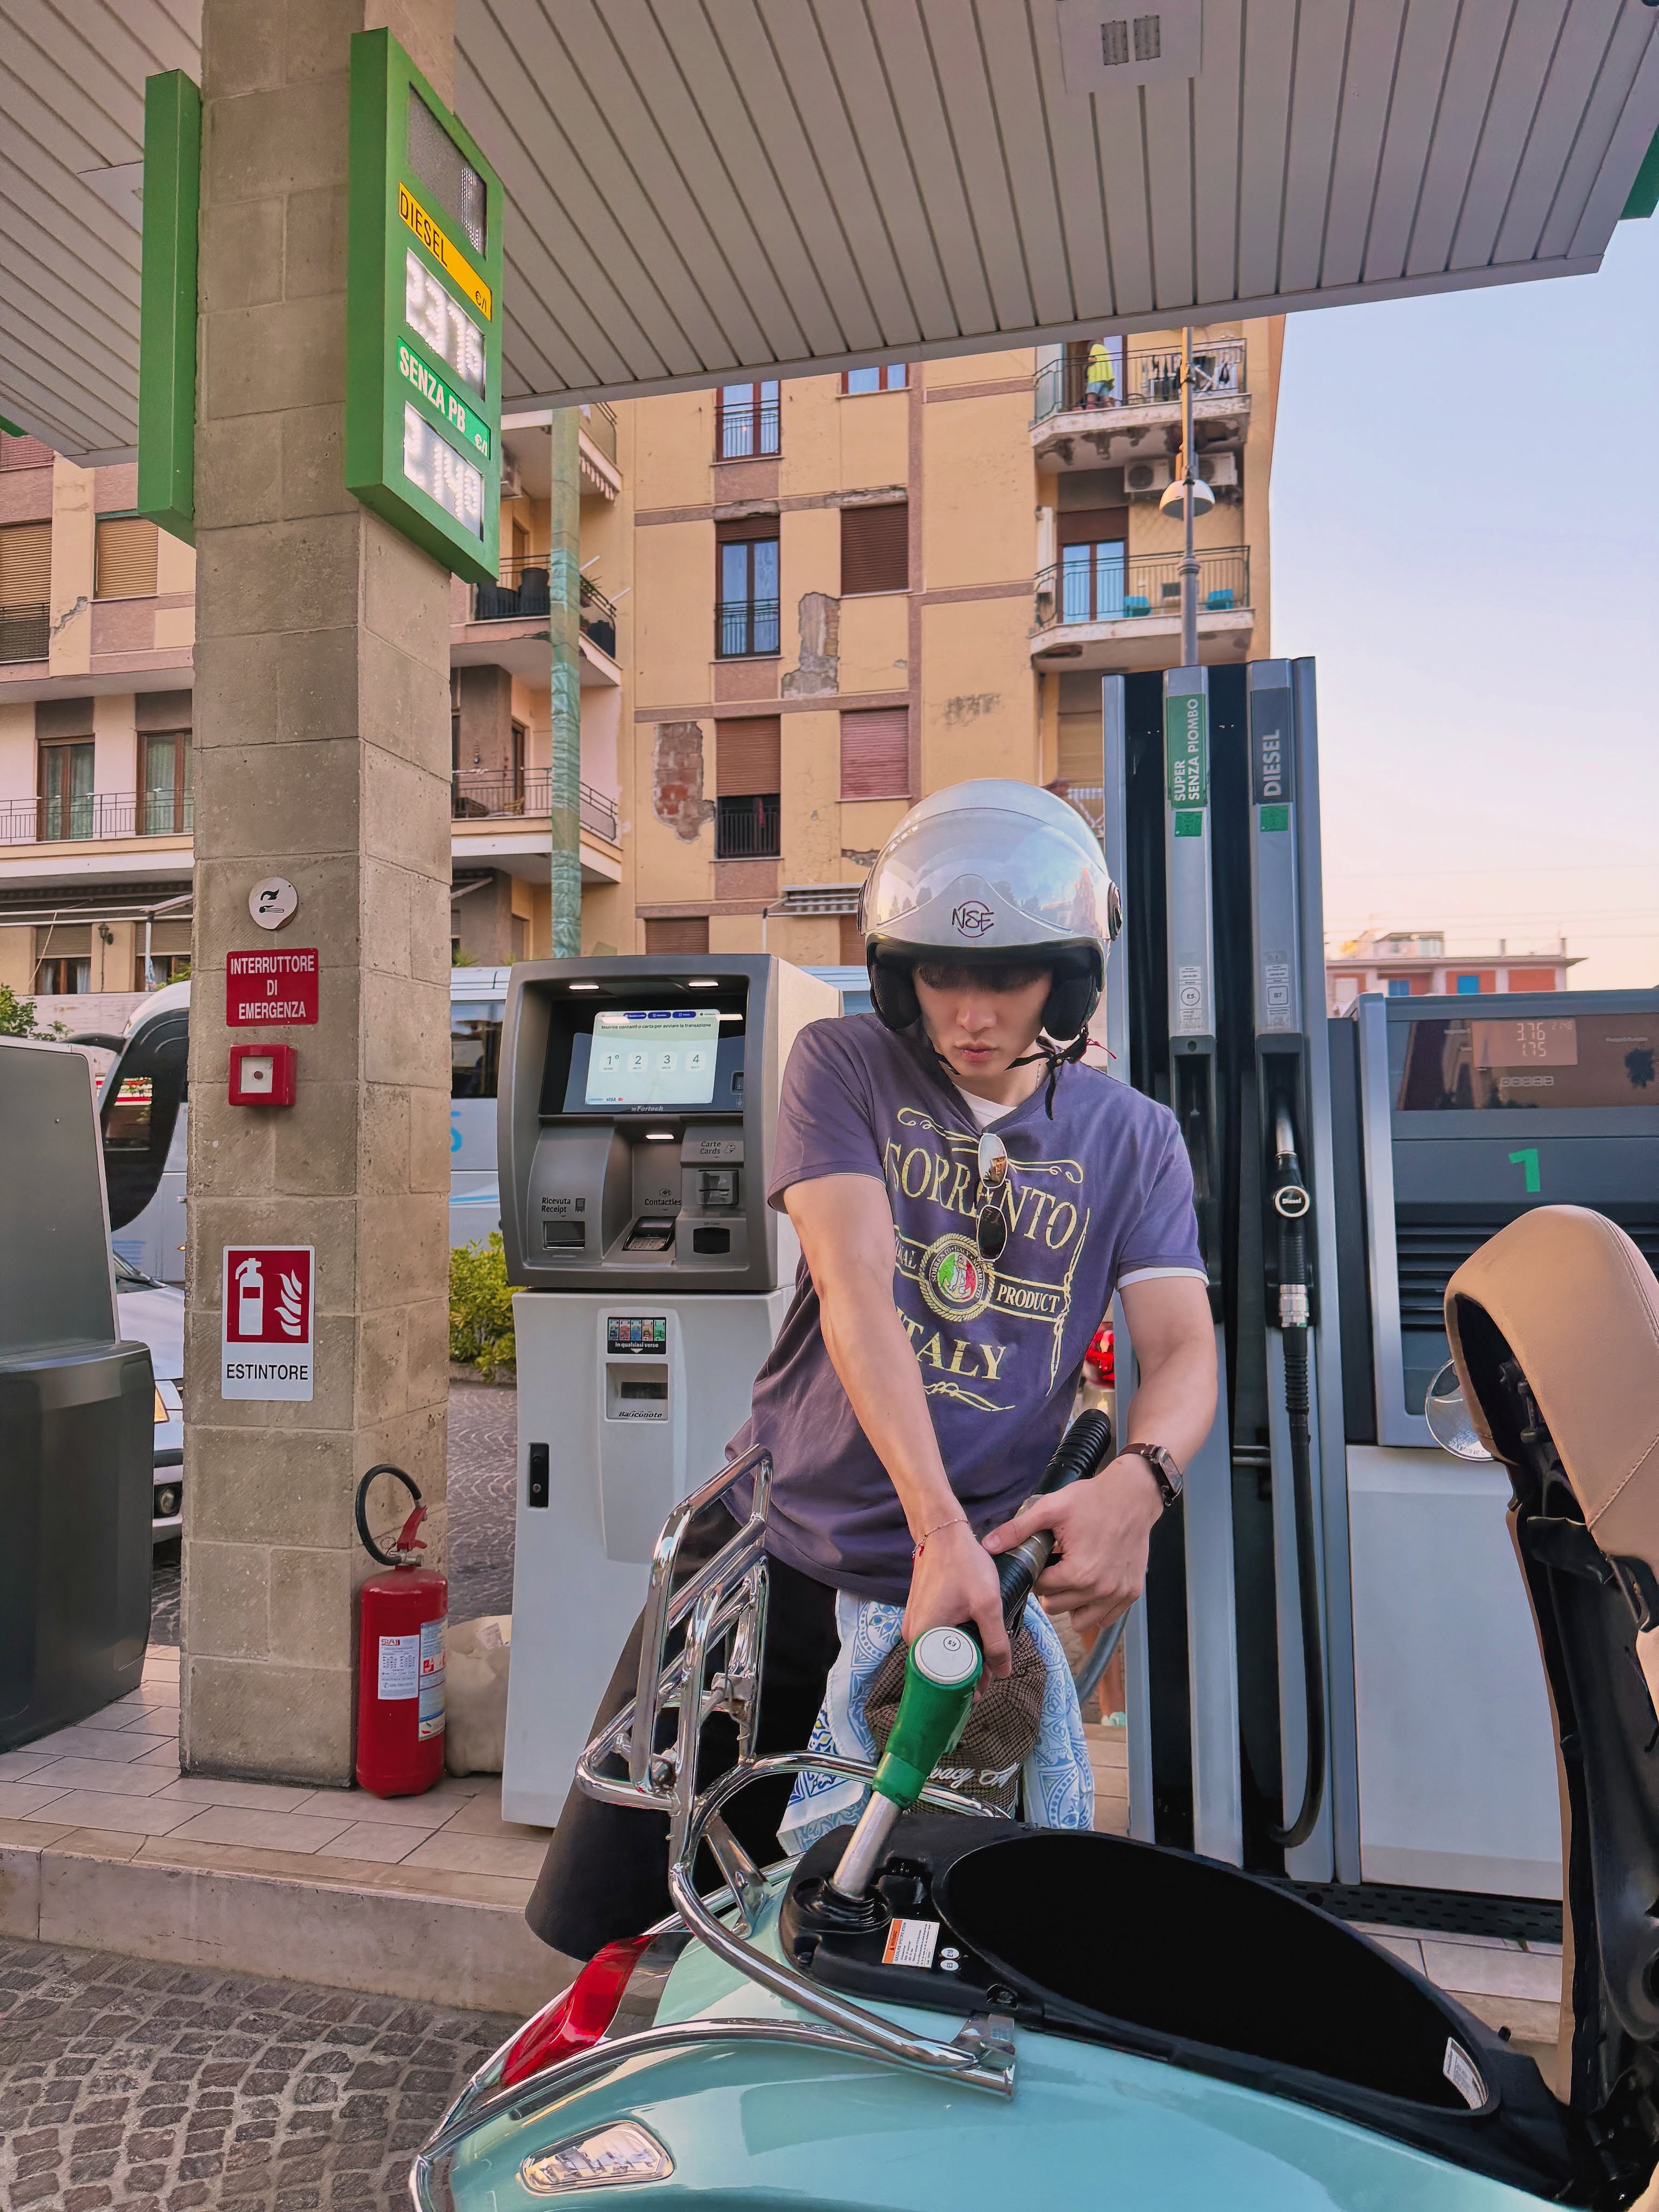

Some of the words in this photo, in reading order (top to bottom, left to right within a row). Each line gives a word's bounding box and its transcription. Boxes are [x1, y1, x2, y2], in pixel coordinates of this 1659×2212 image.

[400, 191, 448, 268] DIESEL
[399, 346, 445, 415] SENZA
[449, 394, 466, 433] PB
[1188, 698, 1199, 753] PIOMBO
[1262, 729, 1282, 797] DIESEL
[1174, 760, 1185, 801] SUPER
[1188, 756, 1199, 800] SENZA
[231, 955, 315, 975] INTERRUTTORE
[266, 979, 278, 996] DI
[238, 1001, 306, 1020] EMERGENZA
[606, 1056, 612, 1065] 1
[635, 1055, 642, 1064] 2
[664, 1055, 671, 1064] 3
[692, 1054, 700, 1063] 4
[1508, 1148, 1541, 1193] 1
[541, 1205, 567, 1214] Receipt
[542, 1197, 571, 1205] Ricevuta
[997, 1283, 1060, 1313] PRODUCT
[227, 1364, 308, 1380] ESTINTORE
